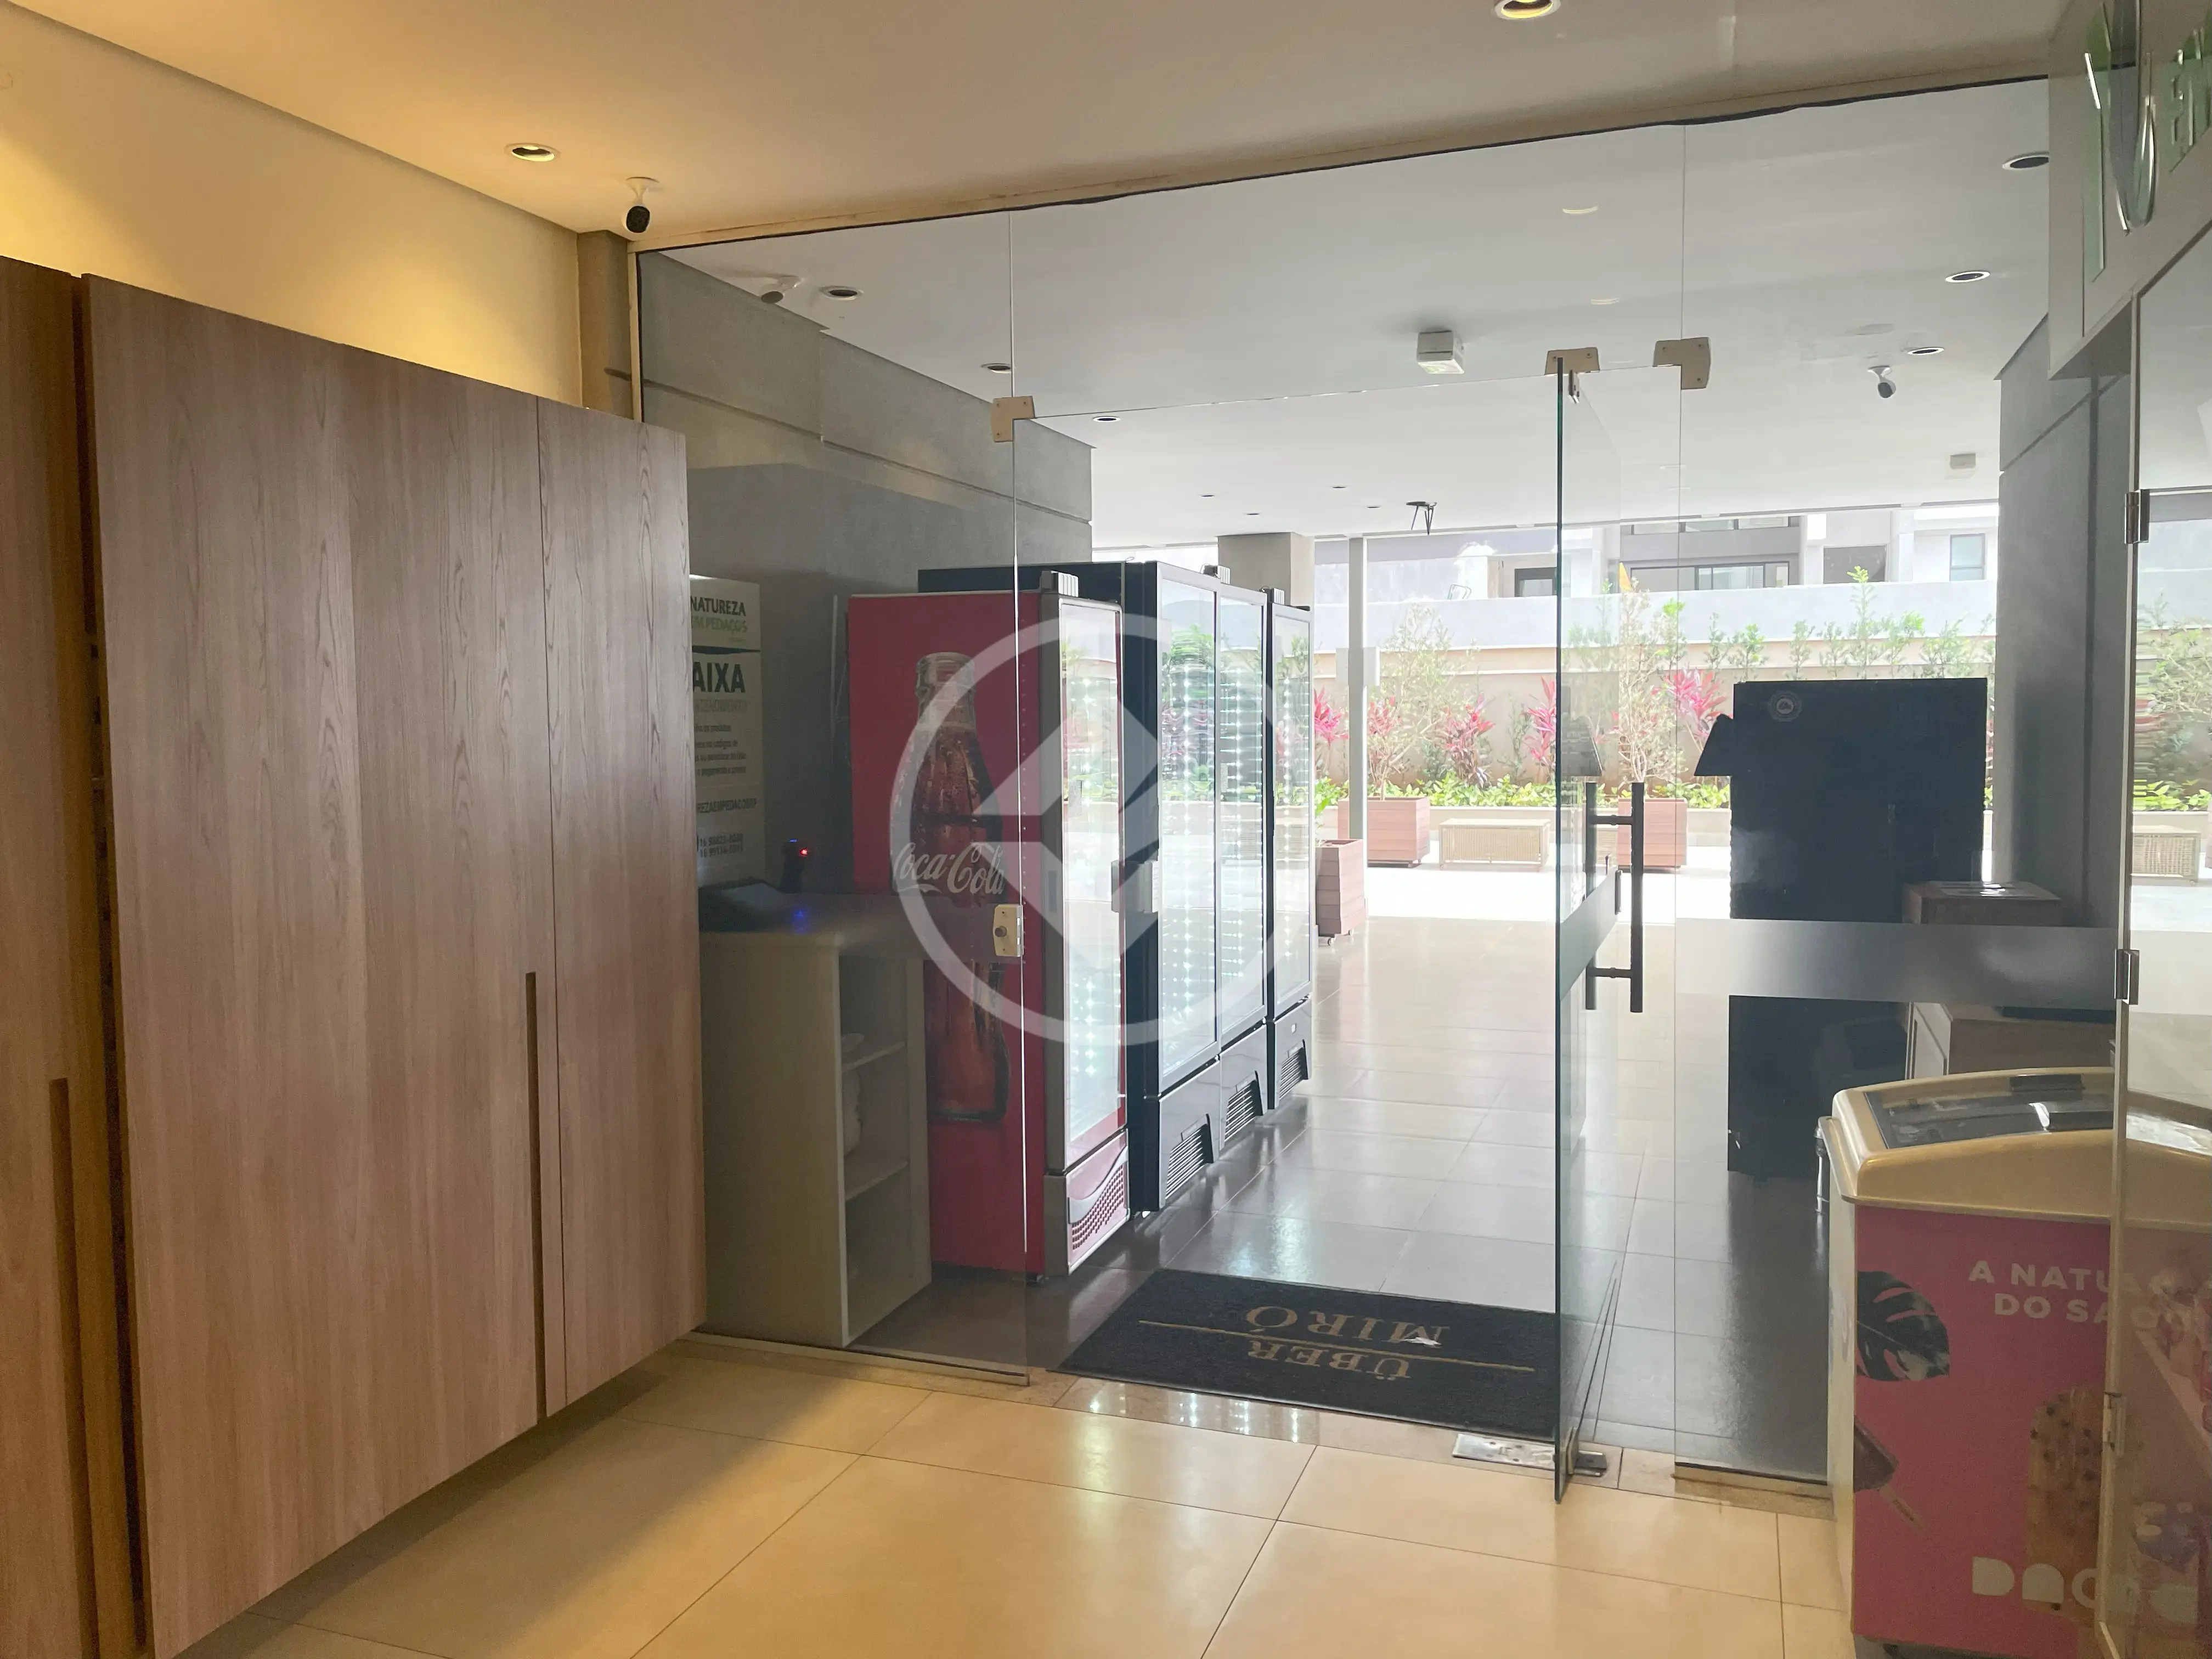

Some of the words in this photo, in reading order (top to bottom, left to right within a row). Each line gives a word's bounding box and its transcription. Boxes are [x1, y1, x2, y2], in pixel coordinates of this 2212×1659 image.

[690, 596, 746, 617] NATUREZA
[893, 842, 1005, 895] Coca-Cola
[1968, 1260, 1994, 1284] A
[1994, 1293, 2051, 1319] DO
[1246, 1306, 1450, 1348] MIRÓ
[1248, 1340, 1411, 1381] ÜBER
